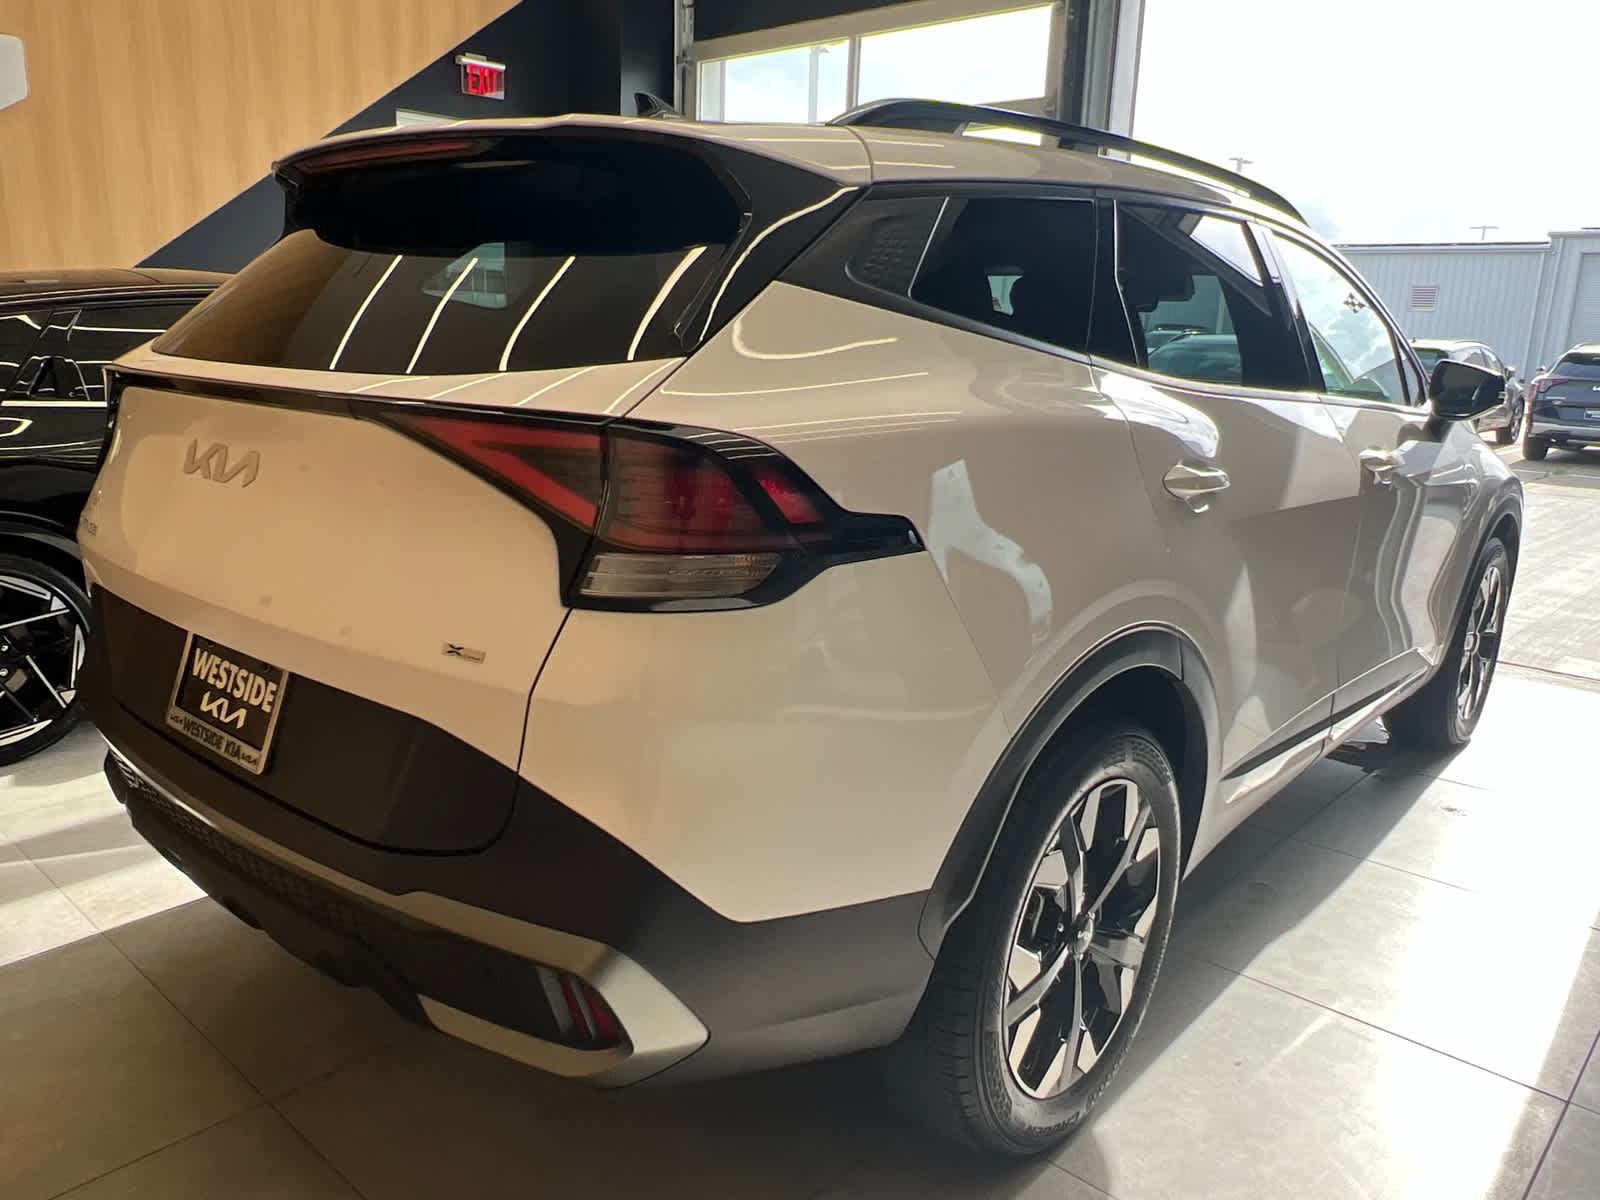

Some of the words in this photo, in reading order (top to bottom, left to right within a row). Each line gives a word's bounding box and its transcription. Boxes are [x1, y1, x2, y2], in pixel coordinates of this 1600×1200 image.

[467, 64, 499, 96] EXIT
[183, 438, 261, 488] KIA
[192, 647, 278, 713] WESTSIDE
[200, 691, 247, 729] KIA
[183, 716, 224, 751] WESTSIDE
[224, 739, 241, 761] KIA
